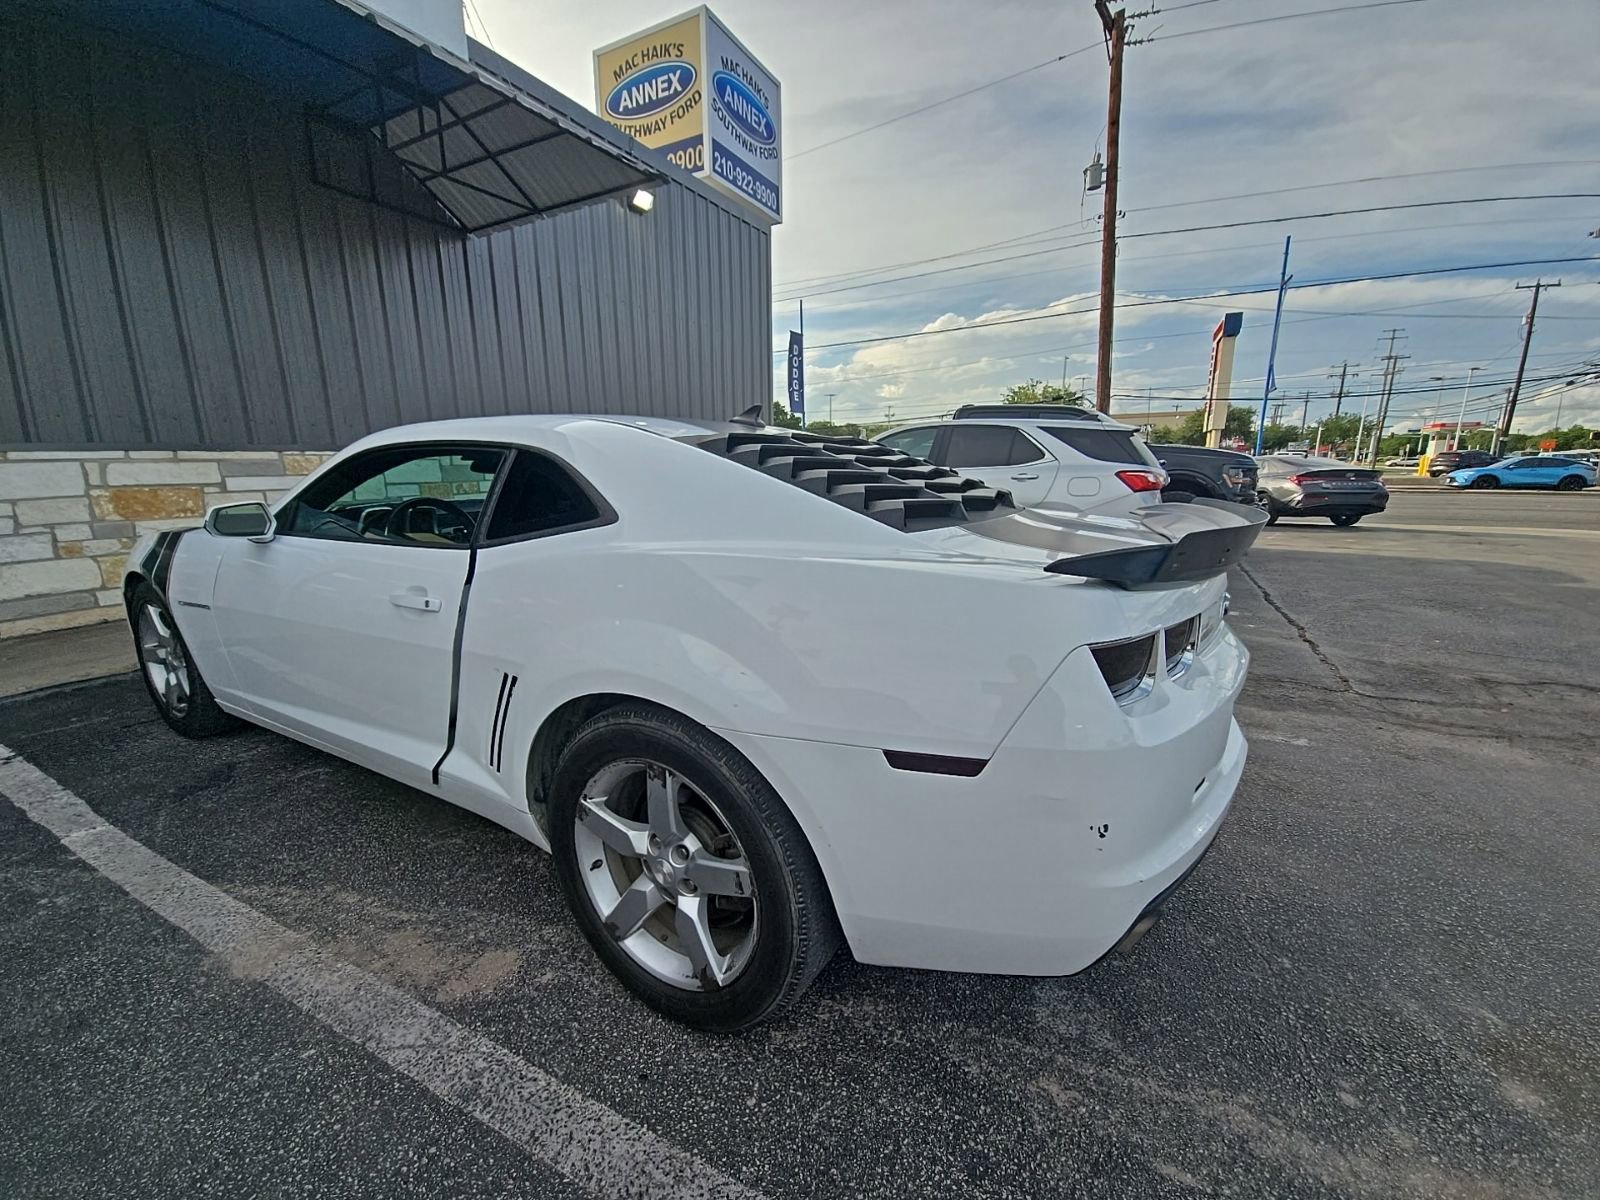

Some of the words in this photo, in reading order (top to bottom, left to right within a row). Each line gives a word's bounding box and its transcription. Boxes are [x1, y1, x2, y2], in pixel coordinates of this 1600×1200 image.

[613, 53, 639, 82] MAC
[641, 43, 684, 64] HAIK'S
[721, 57, 741, 77] MAC
[741, 72, 769, 109] HAIK'S
[619, 69, 682, 112] ANNEX
[669, 90, 702, 125] FORD
[724, 85, 767, 137] ANNEX
[711, 98, 760, 158] SOUTHWAY
[759, 147, 778, 161] FORD
[714, 152, 777, 211] 210-922-9900
